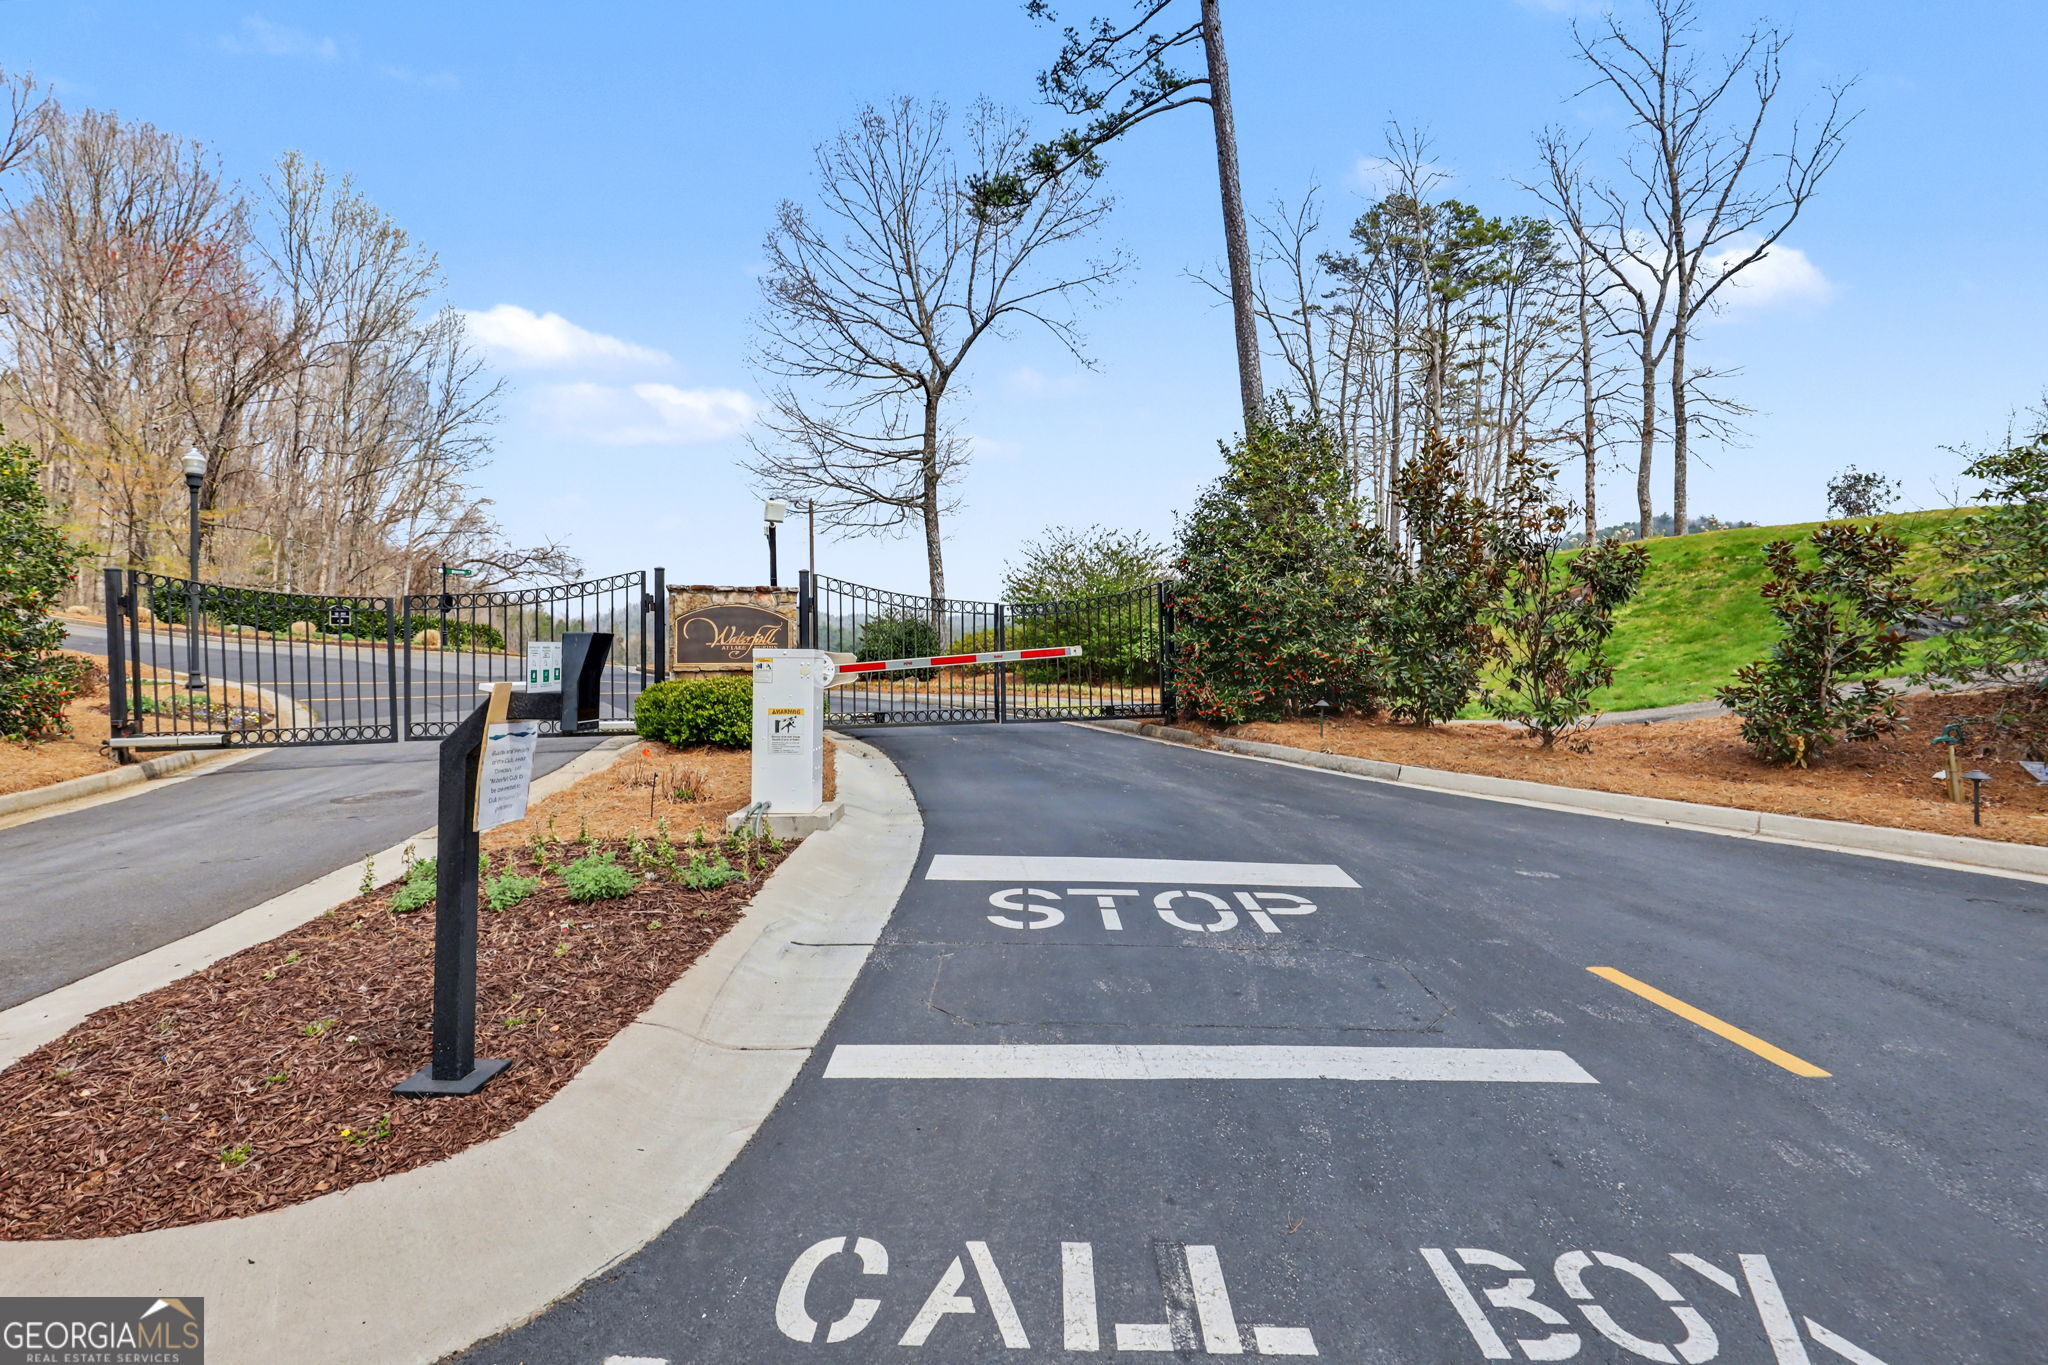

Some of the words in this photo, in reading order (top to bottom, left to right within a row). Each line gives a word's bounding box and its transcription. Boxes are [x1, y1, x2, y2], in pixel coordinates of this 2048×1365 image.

[683, 617, 783, 660] Waterfall
[986, 887, 1318, 933] STOP
[775, 1236, 1319, 1356] CALL
[1420, 1247, 1888, 1365] BOX
